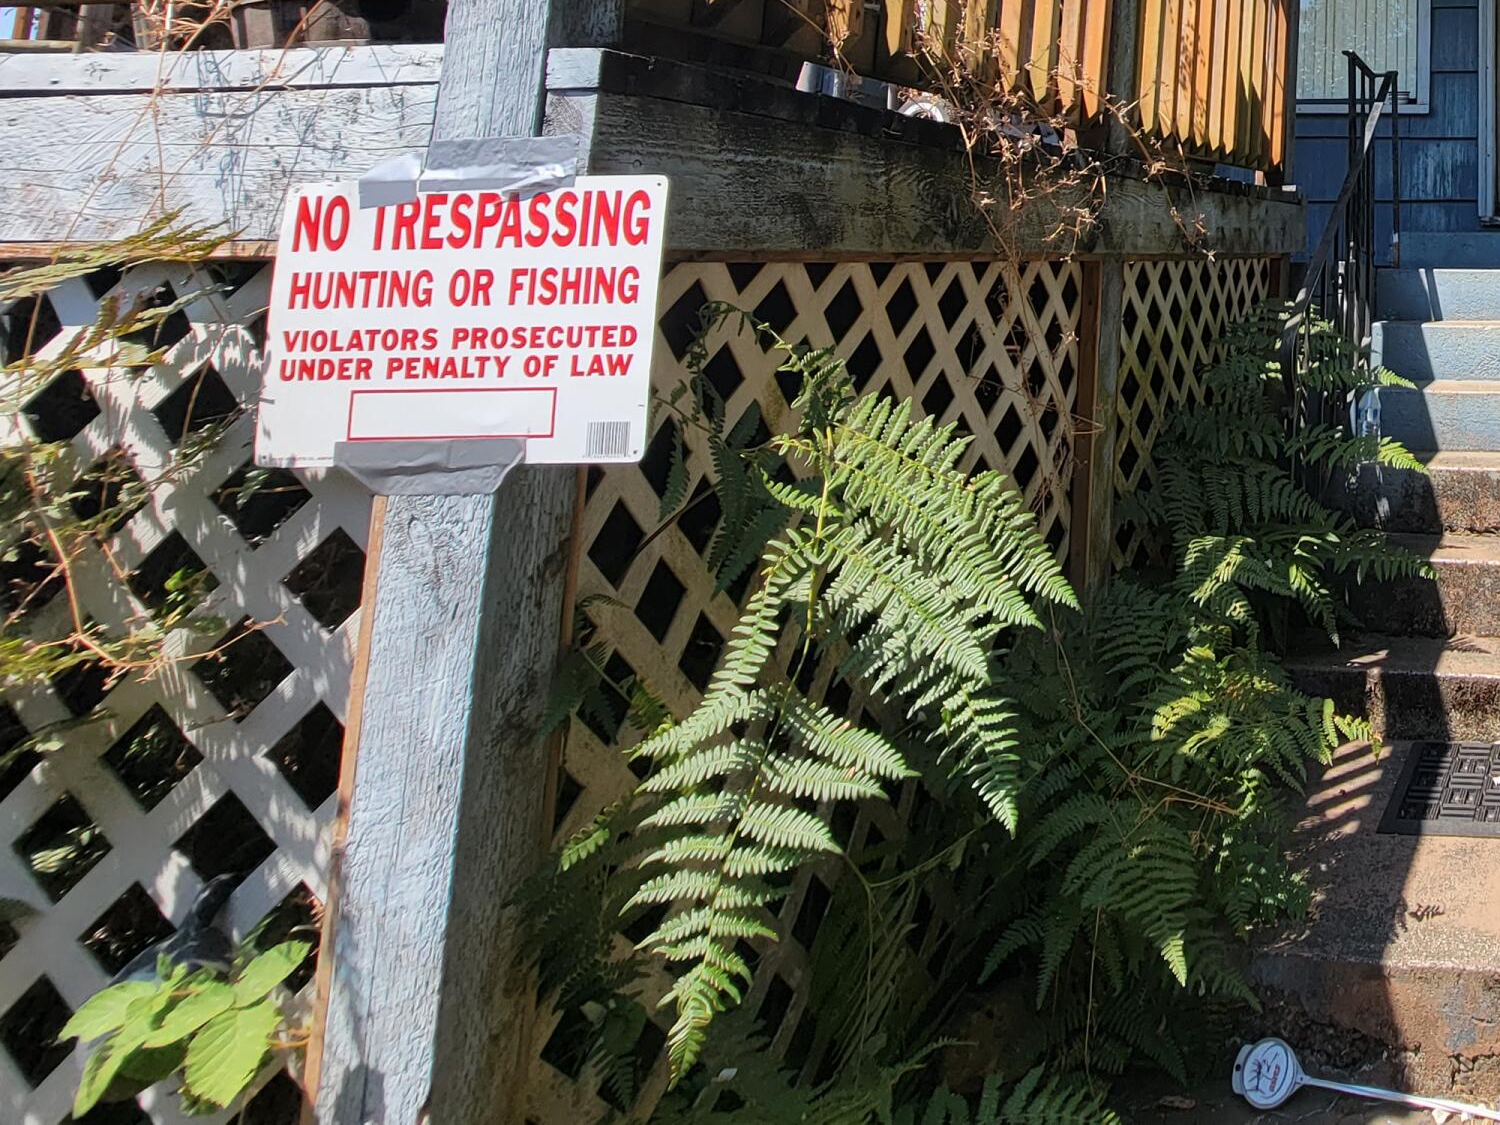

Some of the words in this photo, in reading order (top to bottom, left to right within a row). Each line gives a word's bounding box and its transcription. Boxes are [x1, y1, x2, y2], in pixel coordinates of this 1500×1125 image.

[292, 195, 350, 252] NO
[373, 190, 651, 251] TRESPASSING
[288, 270, 433, 310] HUNTING
[449, 269, 494, 307] OR
[508, 266, 639, 306] FISHING
[284, 328, 438, 353] VIOLATORS
[451, 325, 638, 350] PROSECUTED
[280, 358, 373, 382] UNDER
[386, 355, 511, 379] PENALTY
[523, 355, 558, 378] OF
[570, 354, 633, 377] LAW
